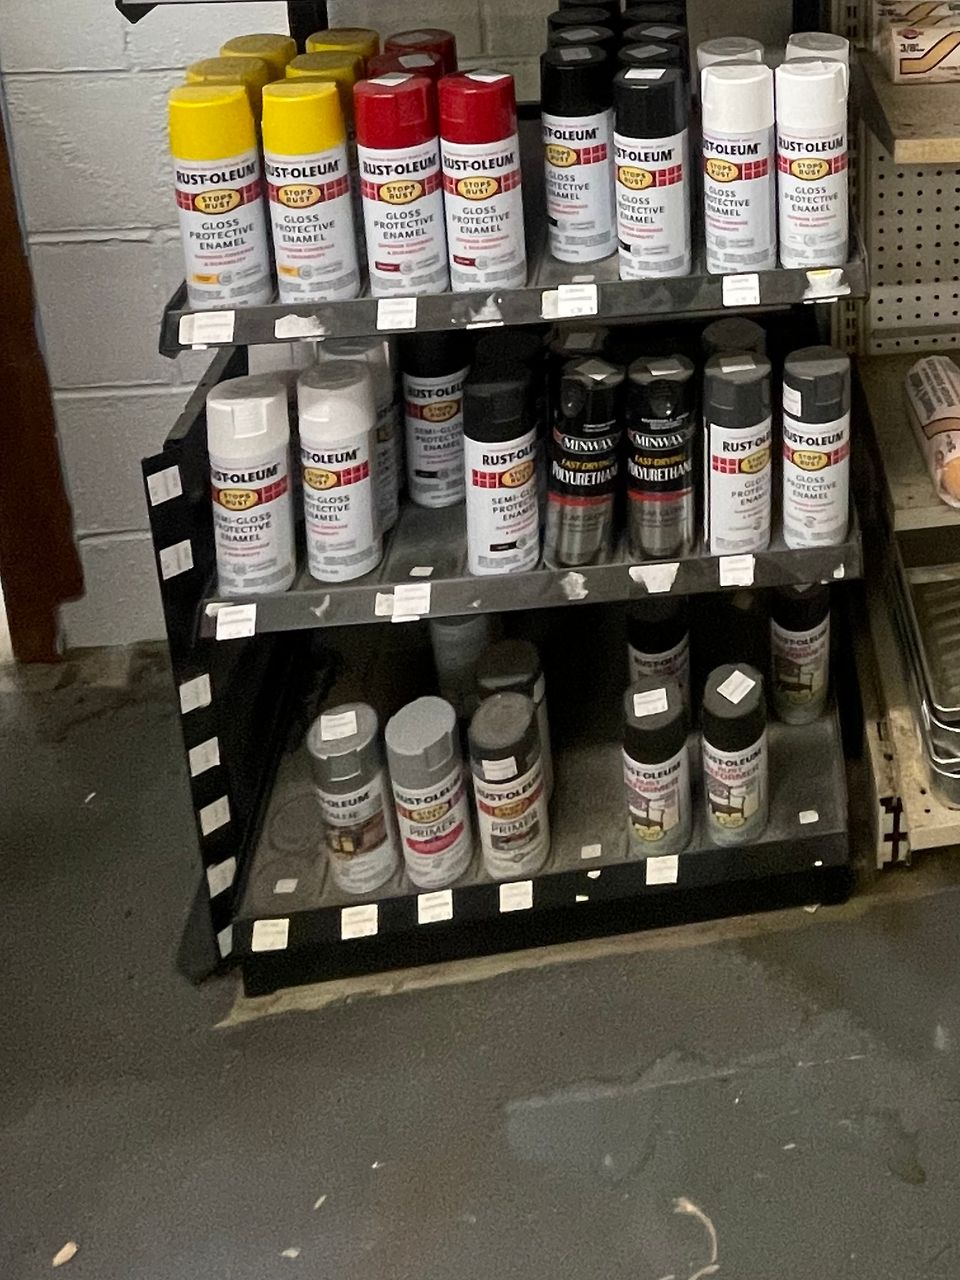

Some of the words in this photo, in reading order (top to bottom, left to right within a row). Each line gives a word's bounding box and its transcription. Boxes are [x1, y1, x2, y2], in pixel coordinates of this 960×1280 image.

[779, 136, 844, 153] RUST-OLEUM
[363, 153, 437, 176] RUST-OLEUM
[444, 154, 514, 171] RUST-OLEUM
[797, 161, 824, 170] STOPS
[176, 163, 256, 186] RUST-OLEUM
[386, 184, 416, 193] STOPS
[463, 180, 492, 189] STOPS
[283, 188, 313, 197] STOPS
[388, 191, 414, 200] RUST
[465, 188, 489, 196] RUST
[708, 185, 737, 198] GLOSS
[795, 186, 827, 195] GLOSS
[202, 193, 234, 203] STOPS
[286, 195, 311, 203] RUST
[621, 194, 650, 205] GLOSS
[784, 192, 839, 205] PROTECTIVE
[204, 200, 231, 210] RUST
[462, 205, 497, 215] GLOSS
[792, 203, 831, 212] ENAMEL
[283, 214, 319, 224] GLOSS
[385, 208, 422, 221] GLOSS
[452, 211, 510, 225] PROTECTIVE
[620, 212, 655, 224] ENAMEL
[201, 218, 240, 232] GLOSS
[275, 220, 335, 234] PROTECTIVE
[374, 214, 434, 231] PROTECTIVE
[189, 223, 254, 241] PROTECTIVE
[383, 227, 427, 241] ENAMEL
[460, 224, 502, 234] ENAMEL
[200, 237, 247, 250] ENAMEL
[282, 233, 326, 244] ENAMEL
[564, 437, 613, 452] MINWAX
[635, 433, 684, 448] MINWAX
[796, 474, 825, 484] GLOSS
[786, 478, 837, 492] PROTECTIVE
[792, 489, 828, 500] ENAMEL
[220, 533, 261, 543] ENAMEL
